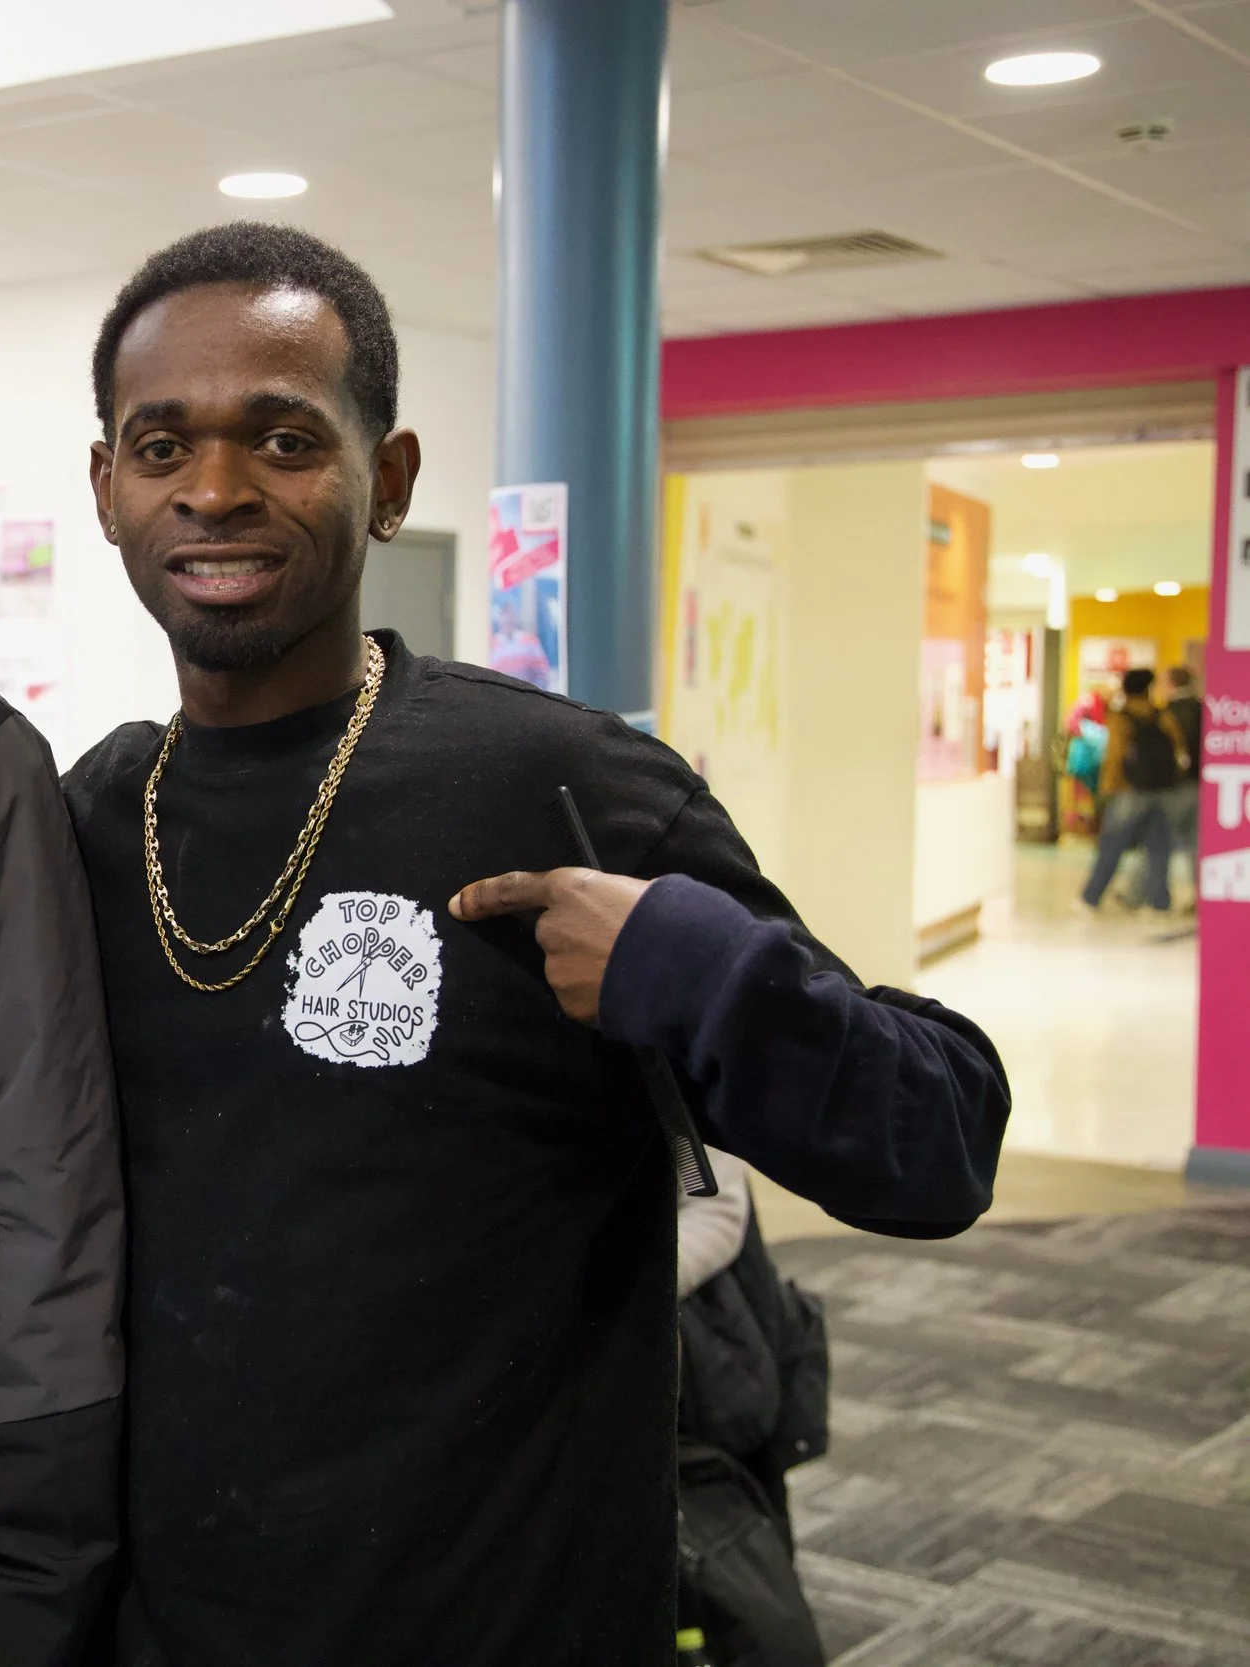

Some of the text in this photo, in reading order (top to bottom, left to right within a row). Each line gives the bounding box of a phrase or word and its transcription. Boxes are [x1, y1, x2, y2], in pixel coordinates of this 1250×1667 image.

[1202, 763, 1250, 830] T
[339, 899, 400, 924] TOP
[305, 927, 427, 991] CHOPPER
[301, 995, 424, 1026] HAIR STUDIOS
